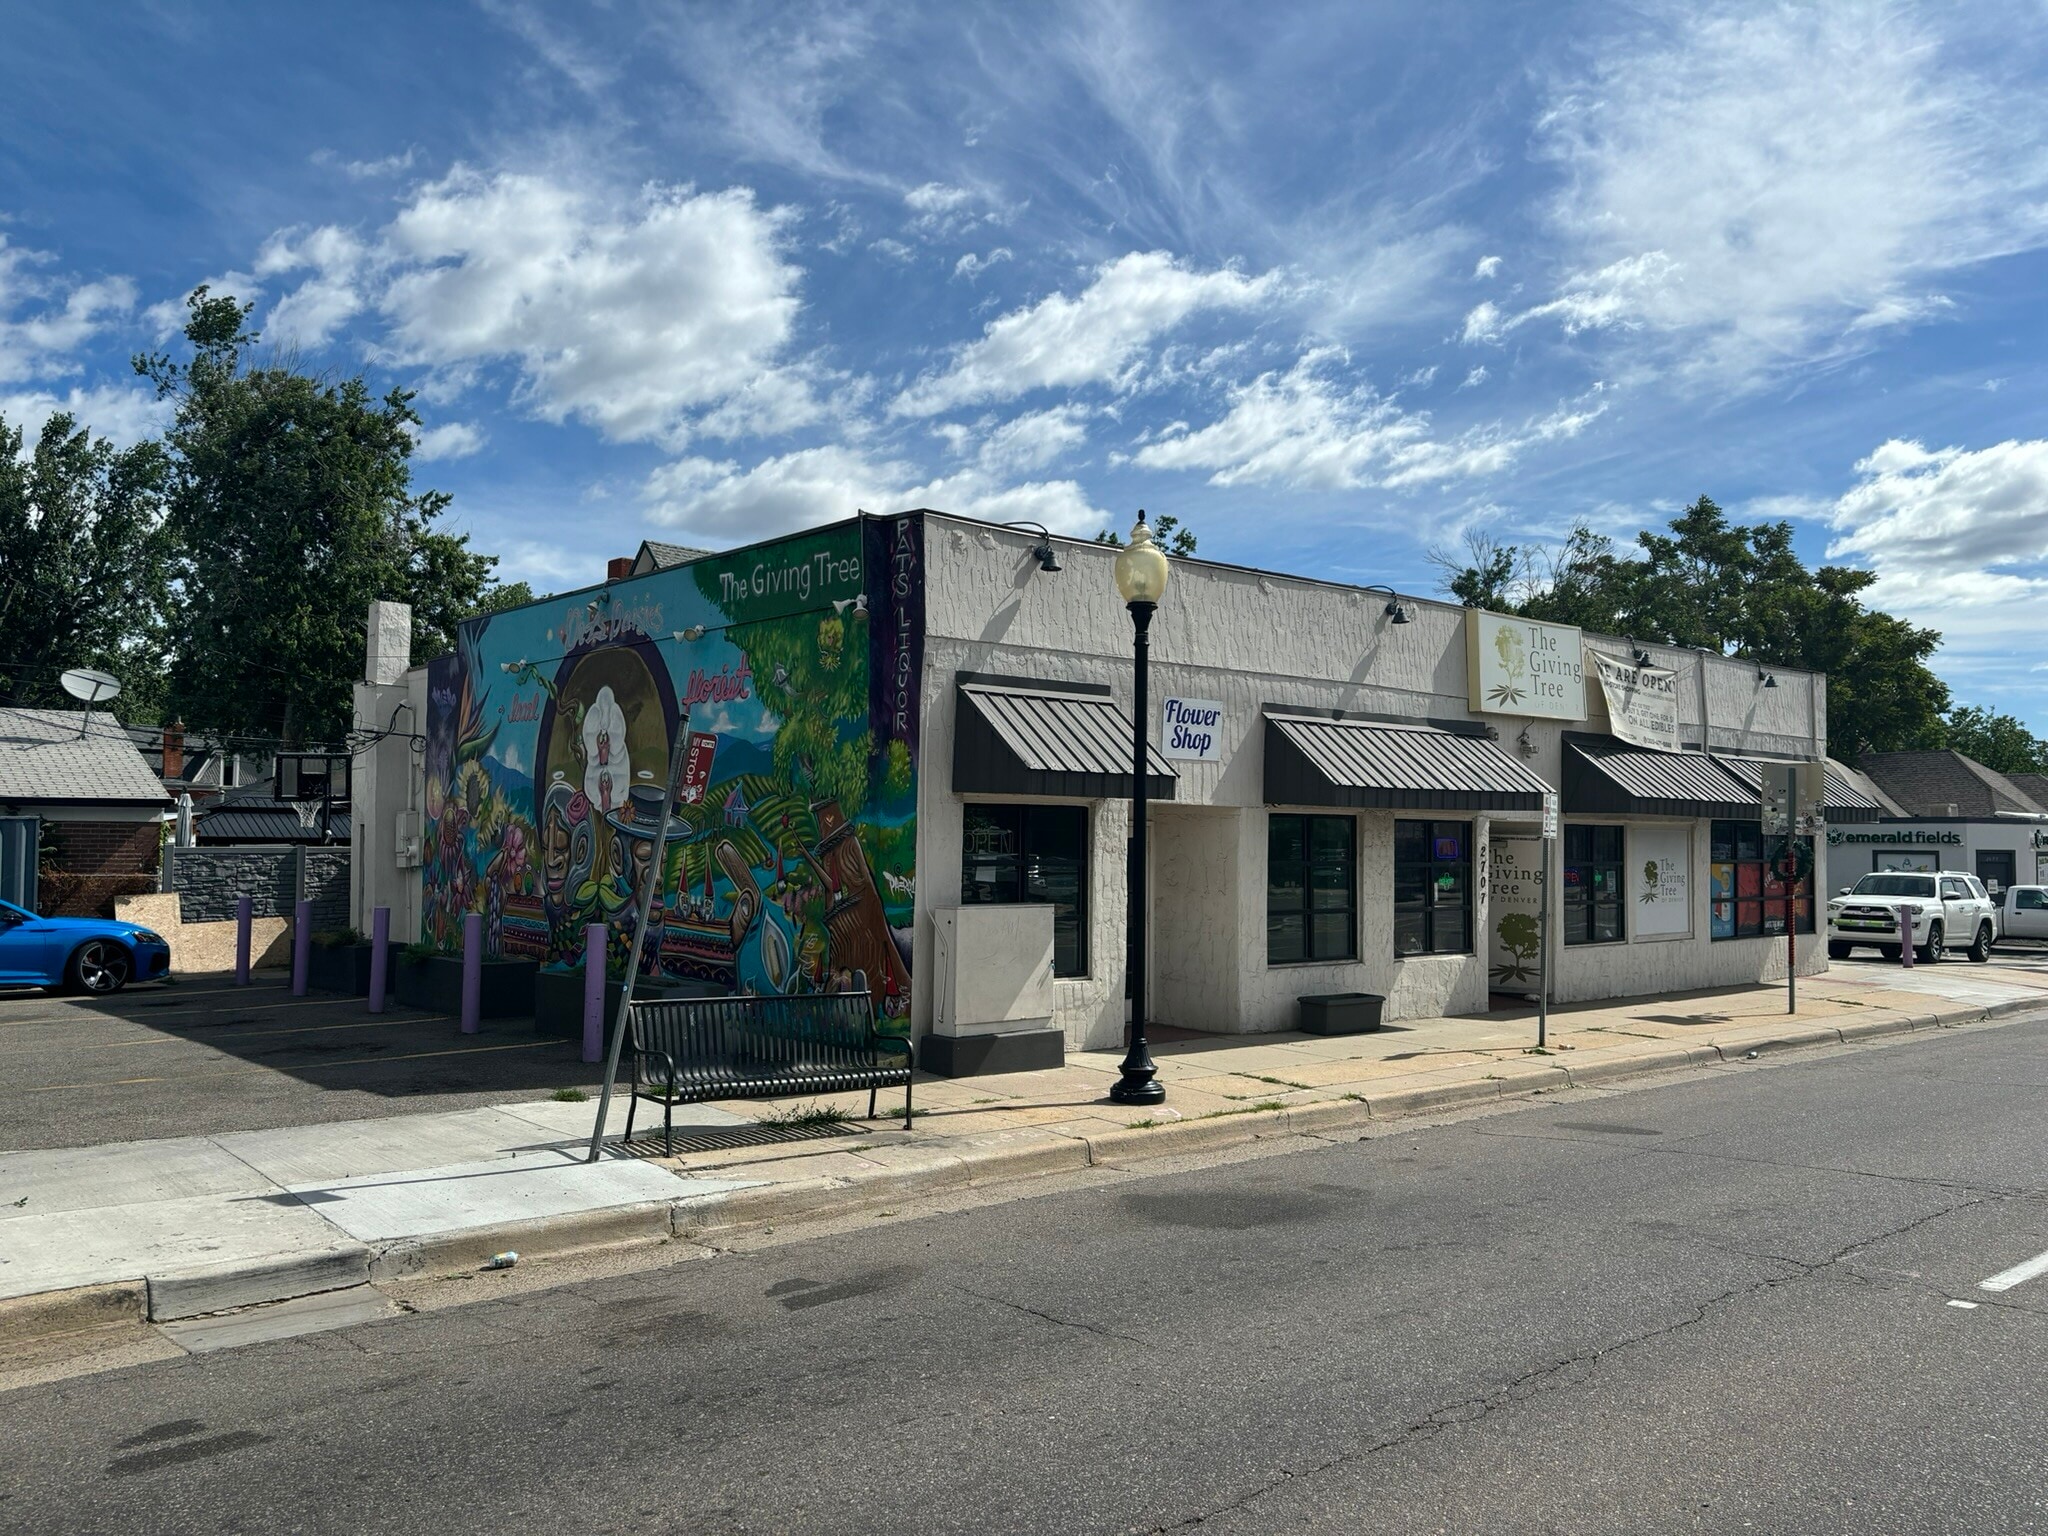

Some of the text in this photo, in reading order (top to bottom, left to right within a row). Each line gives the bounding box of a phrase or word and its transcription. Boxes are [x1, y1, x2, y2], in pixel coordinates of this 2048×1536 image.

[719, 551, 860, 602] The Giving Tree
[1528, 626, 1557, 652] The
[896, 607, 912, 731] LIQUOR
[1529, 651, 1581, 684] Giving
[1615, 667, 1638, 684] ARE
[682, 652, 752, 714] florist
[1531, 674, 1564, 698] Tree
[1165, 699, 1221, 727] Flower
[1628, 715, 1674, 734] ON ALL EDIBLES
[1171, 725, 1211, 757] Shop
[686, 747, 700, 784] STOP
[1845, 831, 1961, 844] emerald fields
[1489, 848, 1514, 865] he
[1660, 859, 1675, 871] The
[1489, 880, 1520, 895] ree
[1660, 872, 1685, 886] Giving
[1501, 896, 1538, 904] DENVER
[1661, 885, 1677, 896] Tree
